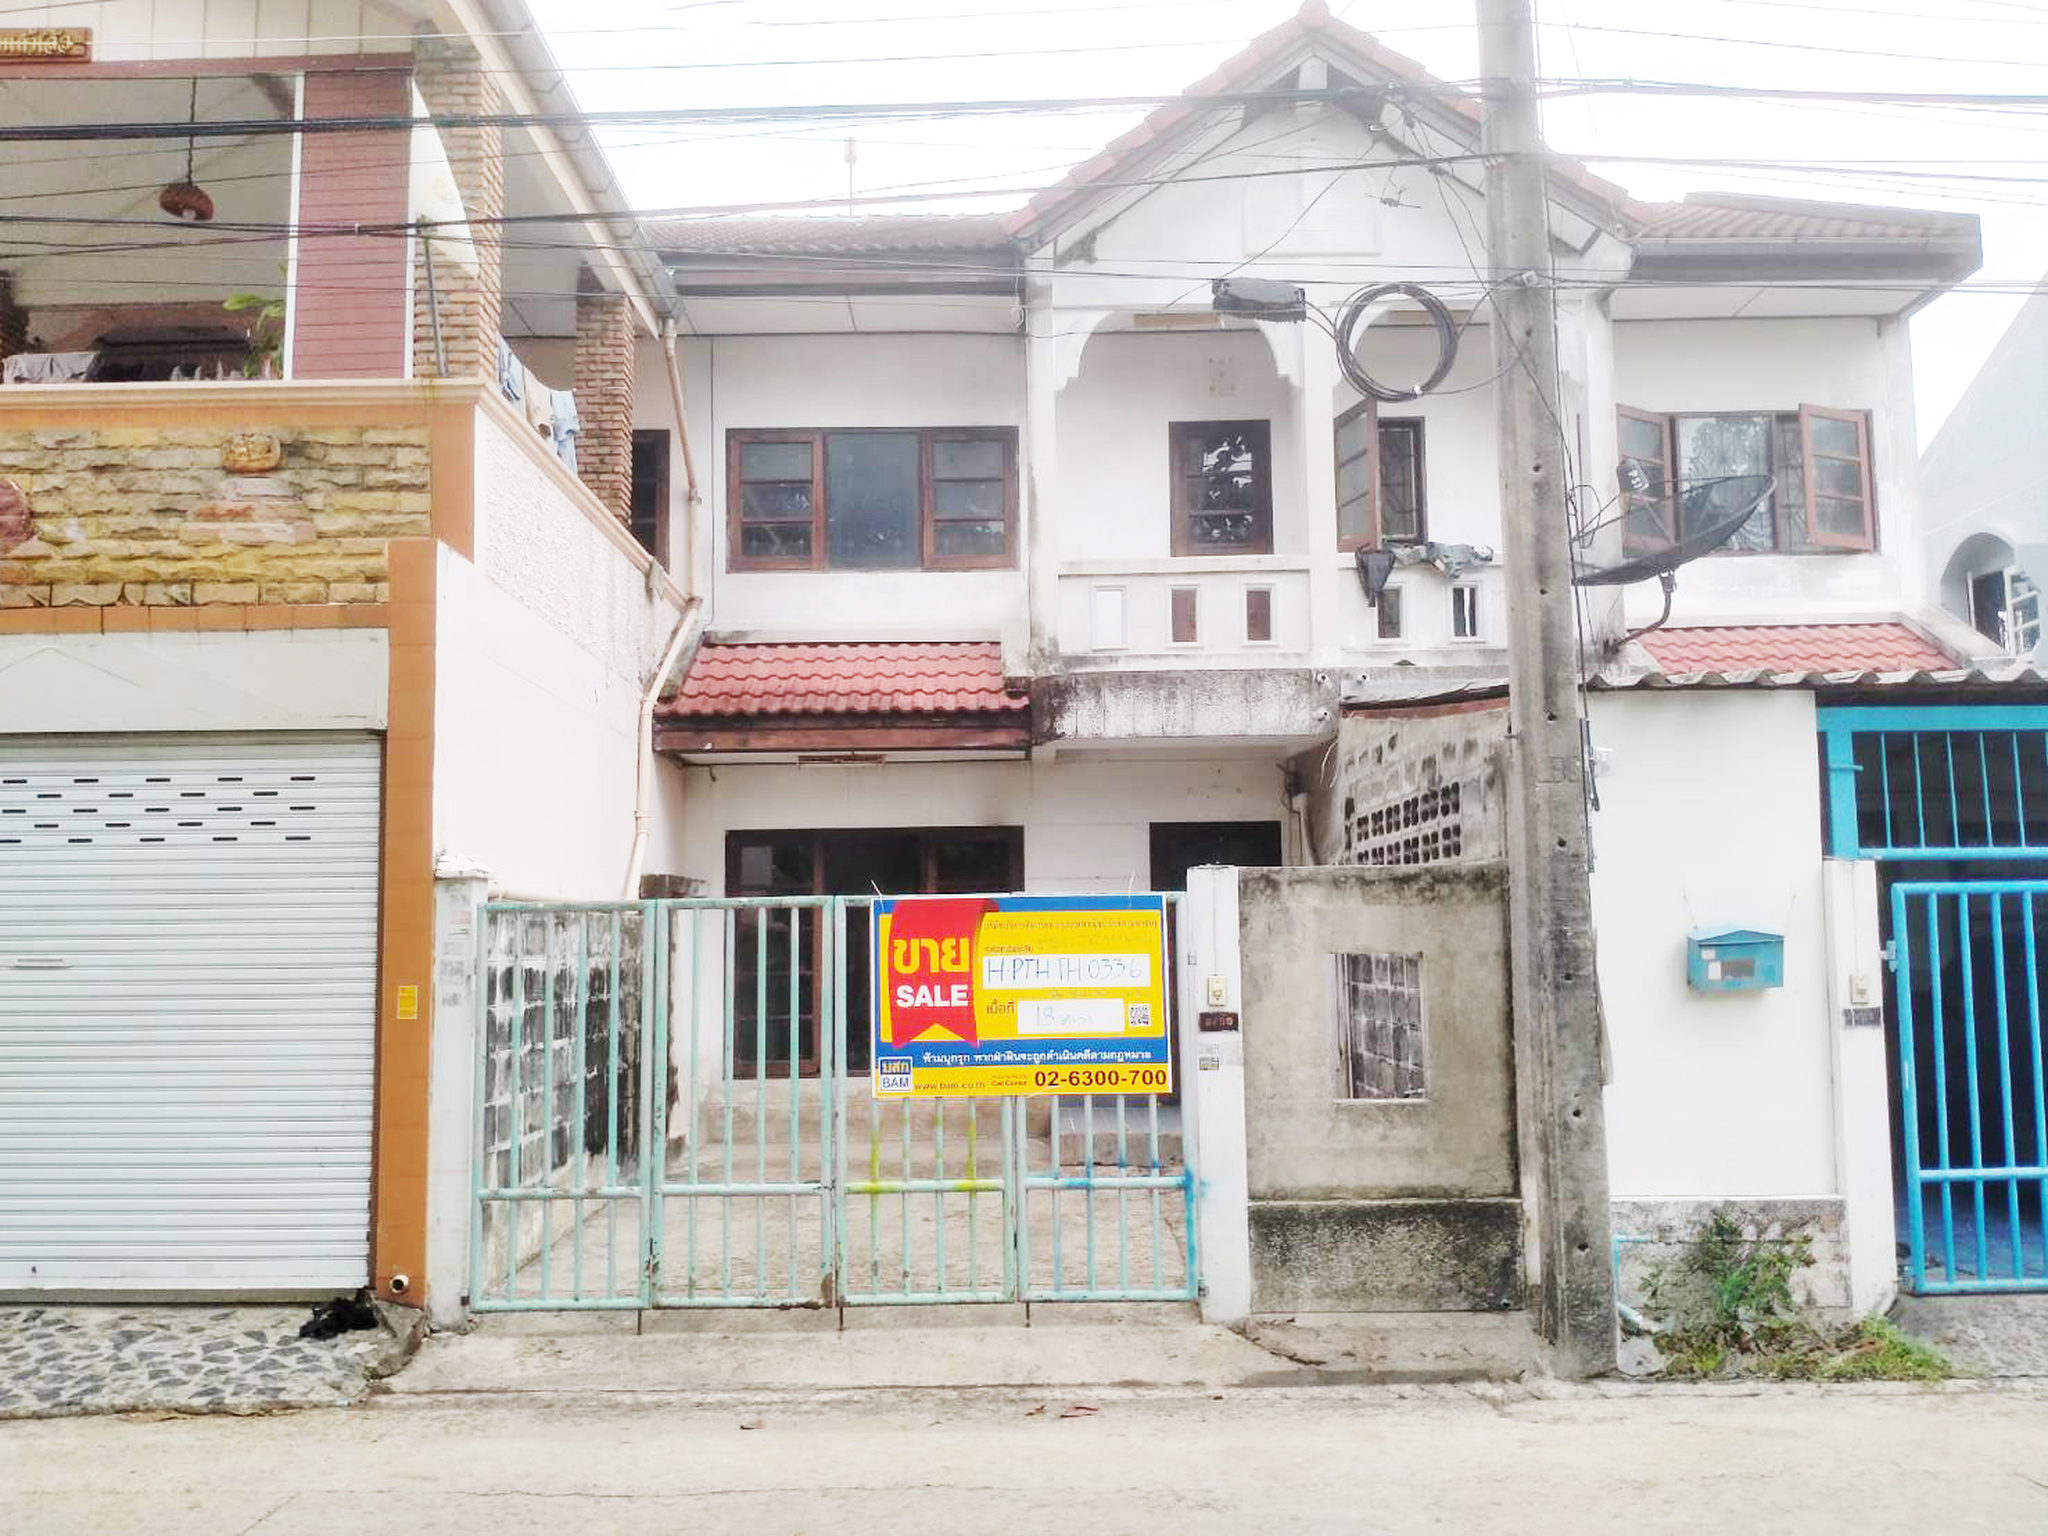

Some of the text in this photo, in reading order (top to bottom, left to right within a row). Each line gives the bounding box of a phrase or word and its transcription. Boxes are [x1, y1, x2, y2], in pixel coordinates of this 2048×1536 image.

[893, 937, 969, 974] ขาย
[896, 984, 968, 1008] SALE
[922, 1051, 970, 1065] ห้ามบุกรุก
[882, 1077, 910, 1089] BAM
[914, 1081, 986, 1090] www.bam.co.th
[1034, 1069, 1167, 1087] 02-6300-700
